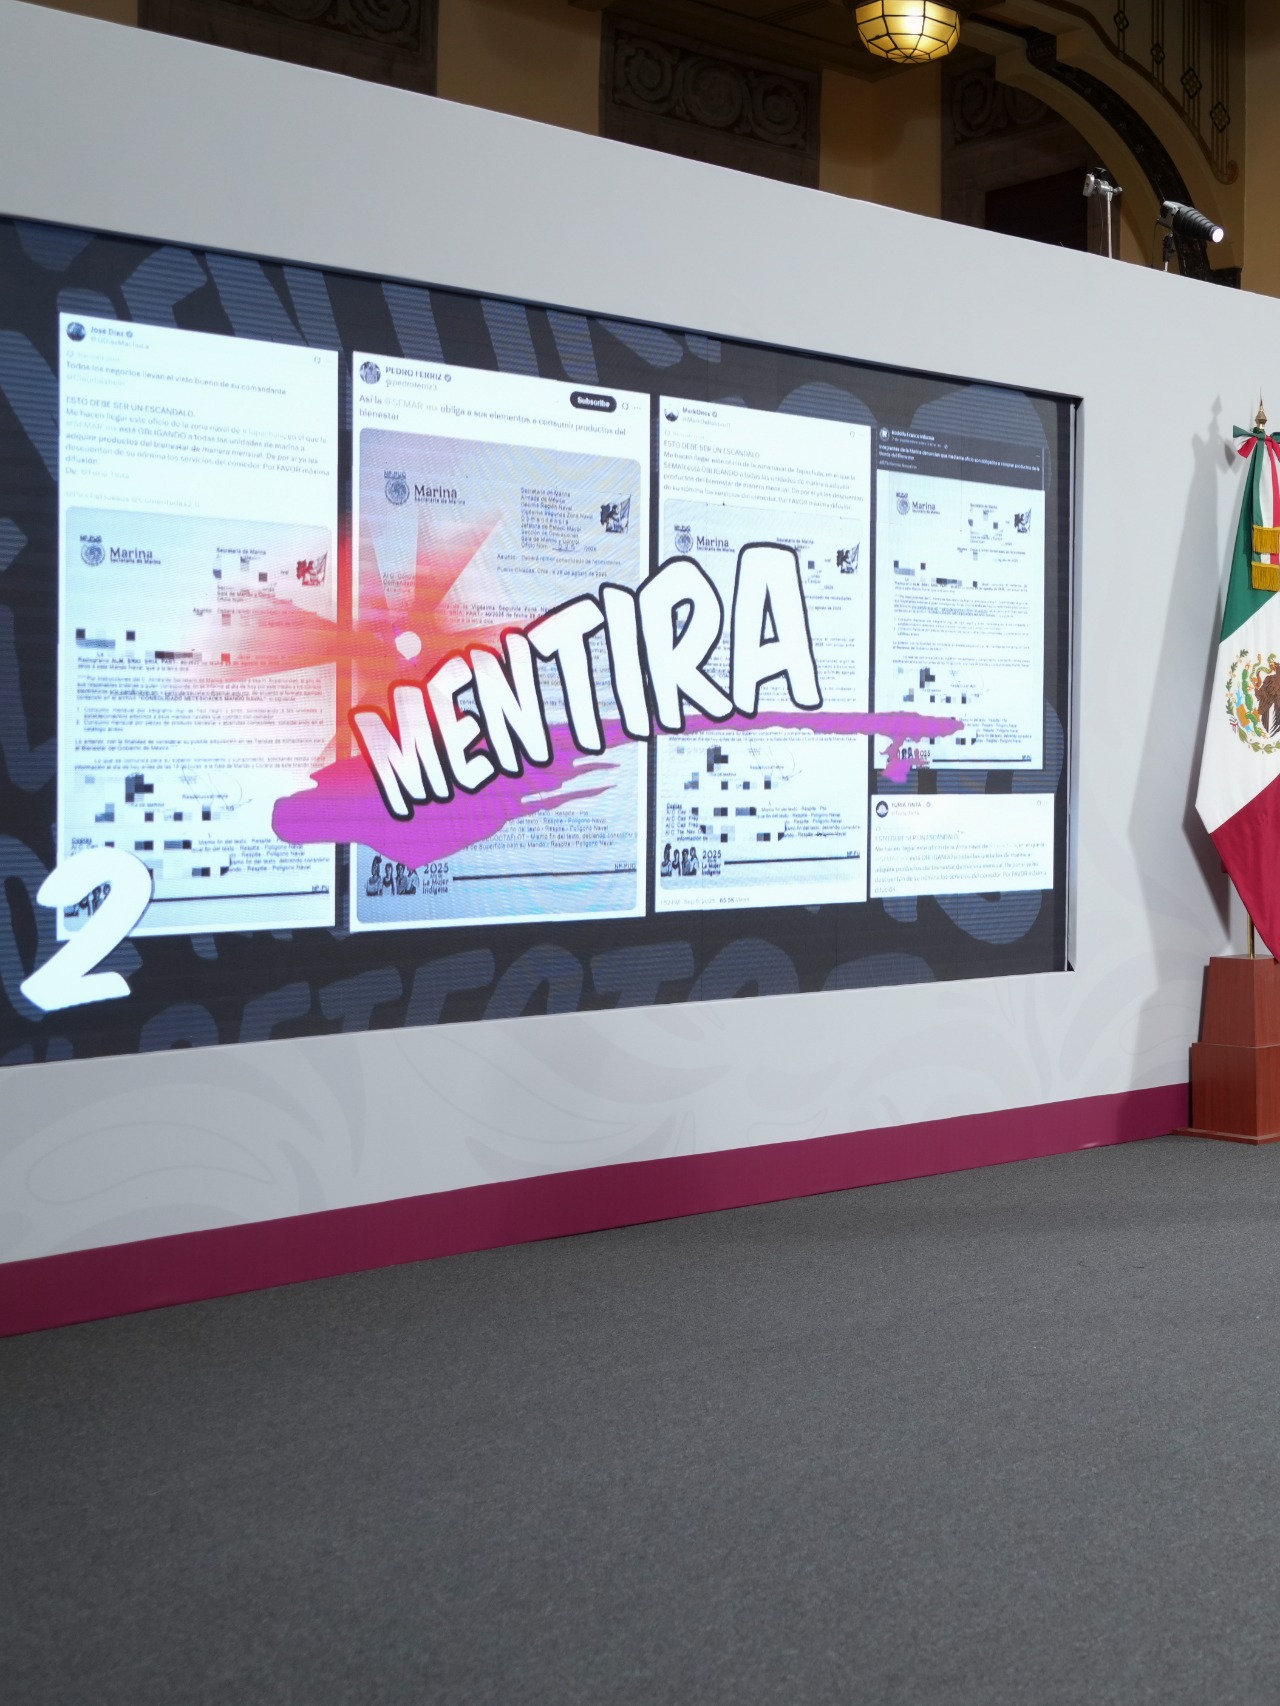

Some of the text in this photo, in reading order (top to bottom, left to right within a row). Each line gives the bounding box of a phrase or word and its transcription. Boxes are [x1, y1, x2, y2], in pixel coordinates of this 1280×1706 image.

[577, 396, 610, 407] Subscribe
[359, 407, 399, 420] bienestar
[414, 483, 457, 499] Marina
[912, 501, 935, 510] Marina
[696, 534, 728, 548] Marina
[110, 544, 152, 559] Marina
[349, 541, 823, 821] MENTIRA
[702, 849, 721, 858] 2025
[424, 862, 448, 873] 2025
[20, 847, 154, 1011] 2
